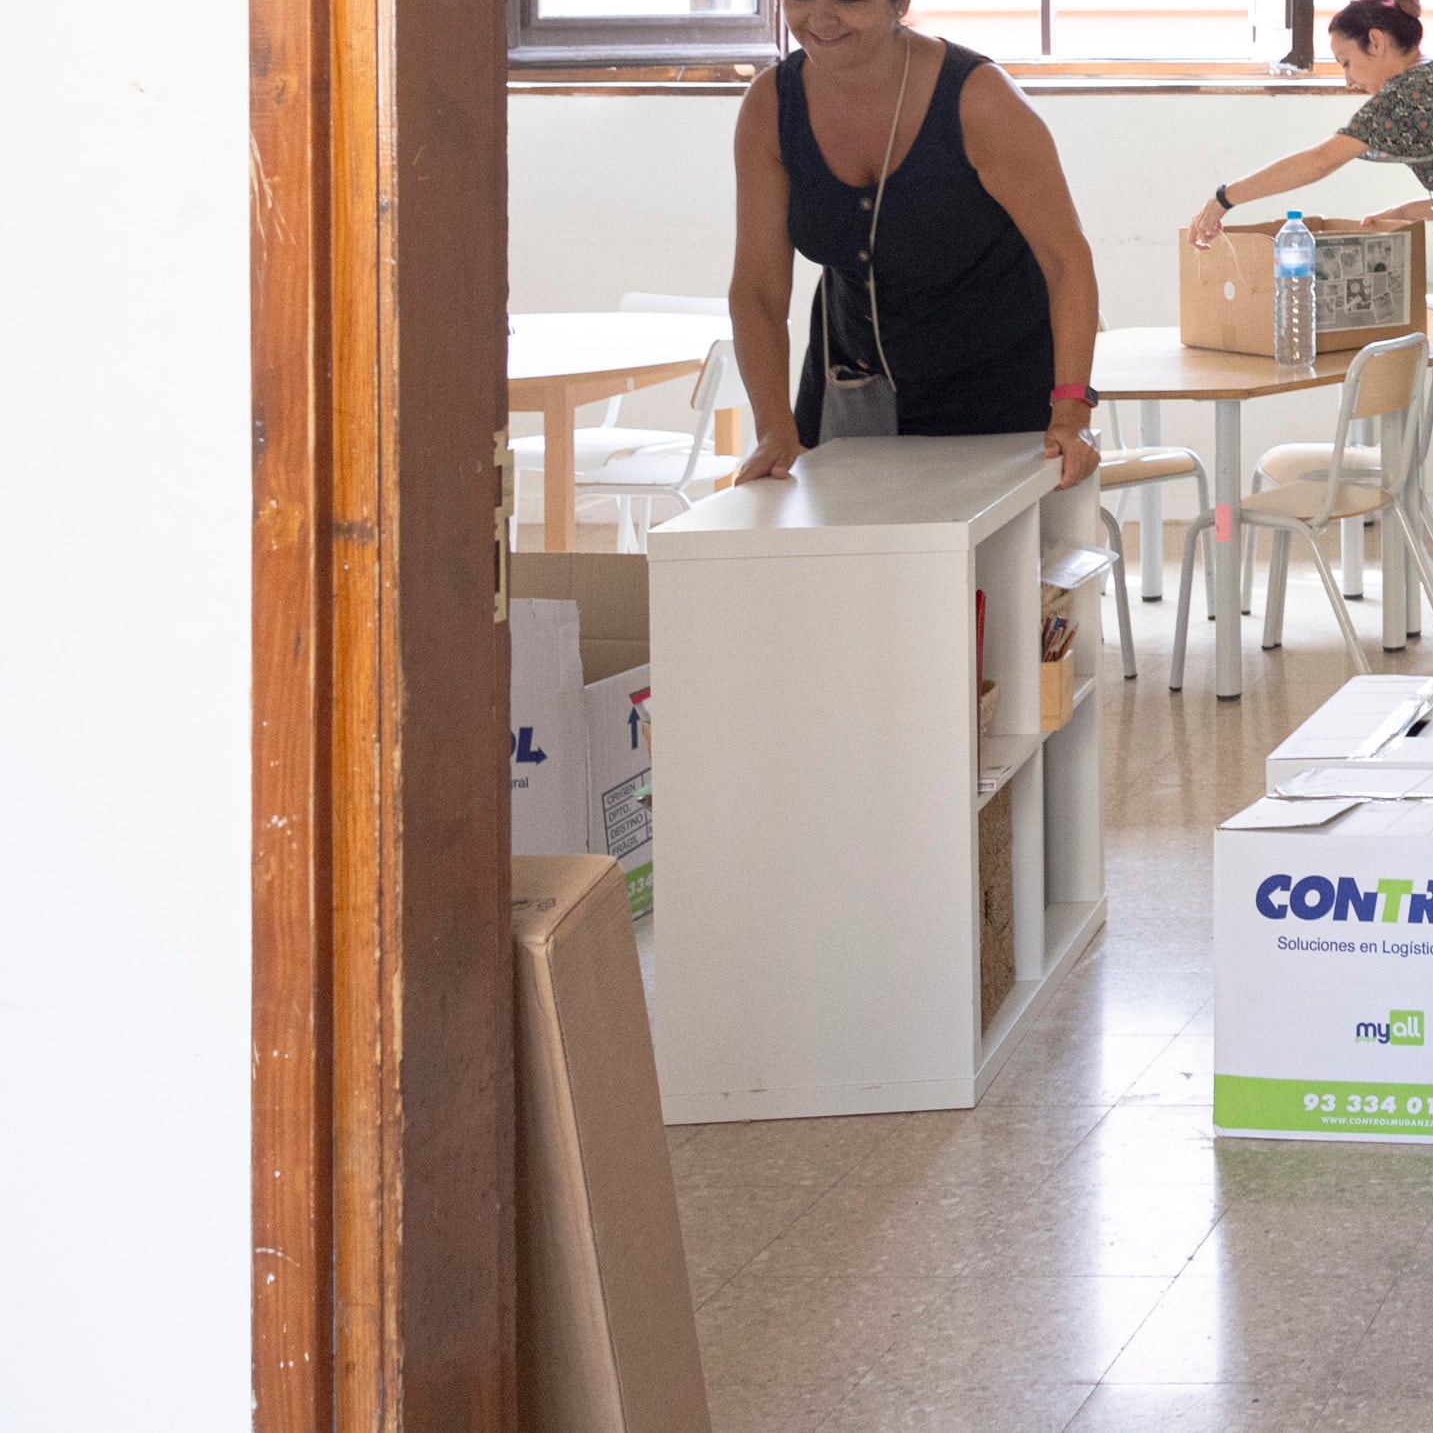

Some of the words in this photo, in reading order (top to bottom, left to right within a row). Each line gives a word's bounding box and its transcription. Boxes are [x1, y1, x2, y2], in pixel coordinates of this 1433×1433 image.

[606, 783, 637, 806] ORIGEN
[610, 813, 644, 839] DESTINO
[1277, 935, 1356, 953] Soluciones
[1359, 942, 1378, 954] en
[1303, 1093, 1337, 1112] 93
[1346, 1094, 1397, 1114] 334
